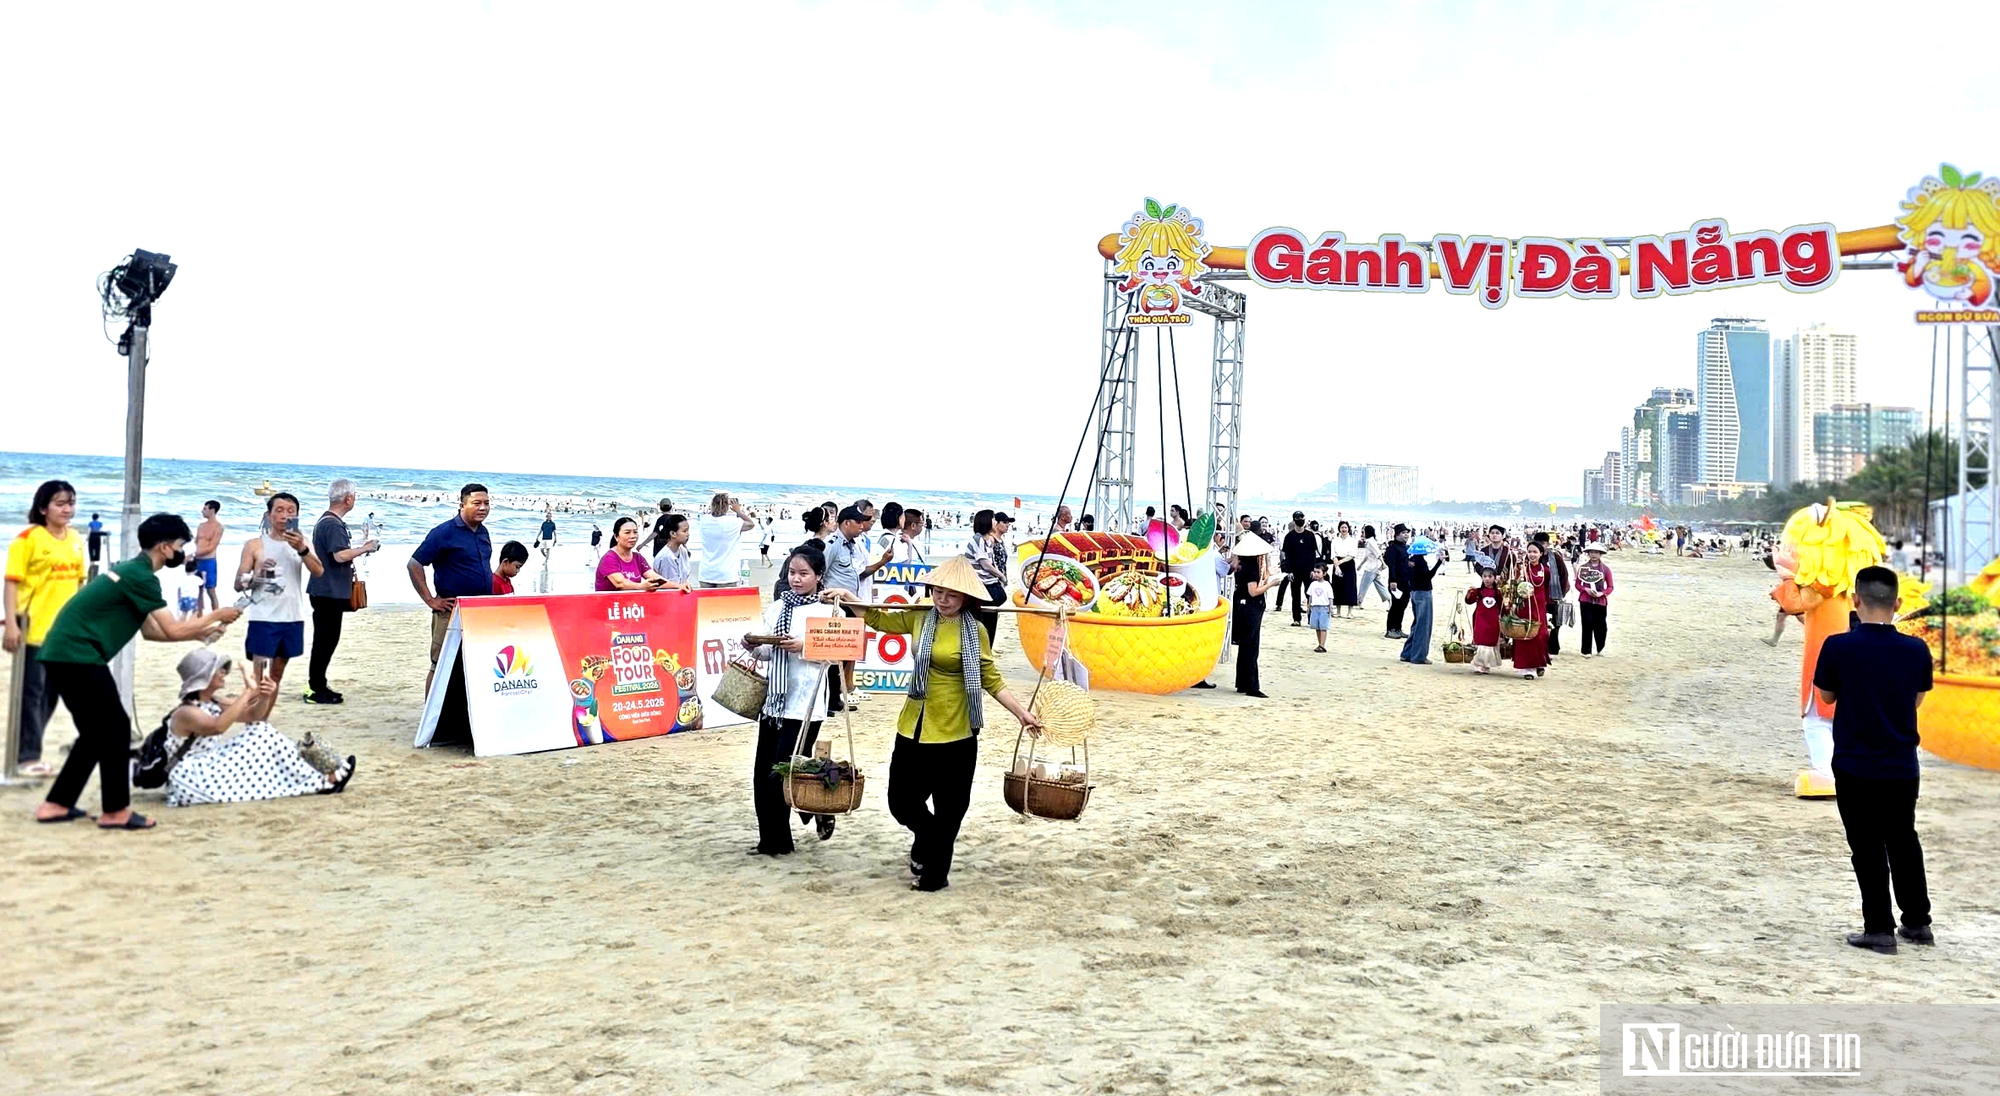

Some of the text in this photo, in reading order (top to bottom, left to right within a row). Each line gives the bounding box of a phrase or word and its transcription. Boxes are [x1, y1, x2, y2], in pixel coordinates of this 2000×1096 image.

[1252, 225, 1834, 303] Gánh Vị Đà Nẵng
[1917, 312, 1953, 322] NGON
[608, 601, 645, 622] LỄ HỘI
[616, 634, 644, 645] DANANG
[612, 647, 650, 666] FOOD
[615, 664, 653, 682] TOUR
[493, 679, 538, 693] DANANG
[614, 682, 643, 693] FESTIVAL
[612, 697, 665, 713] 20-24.5.2026
